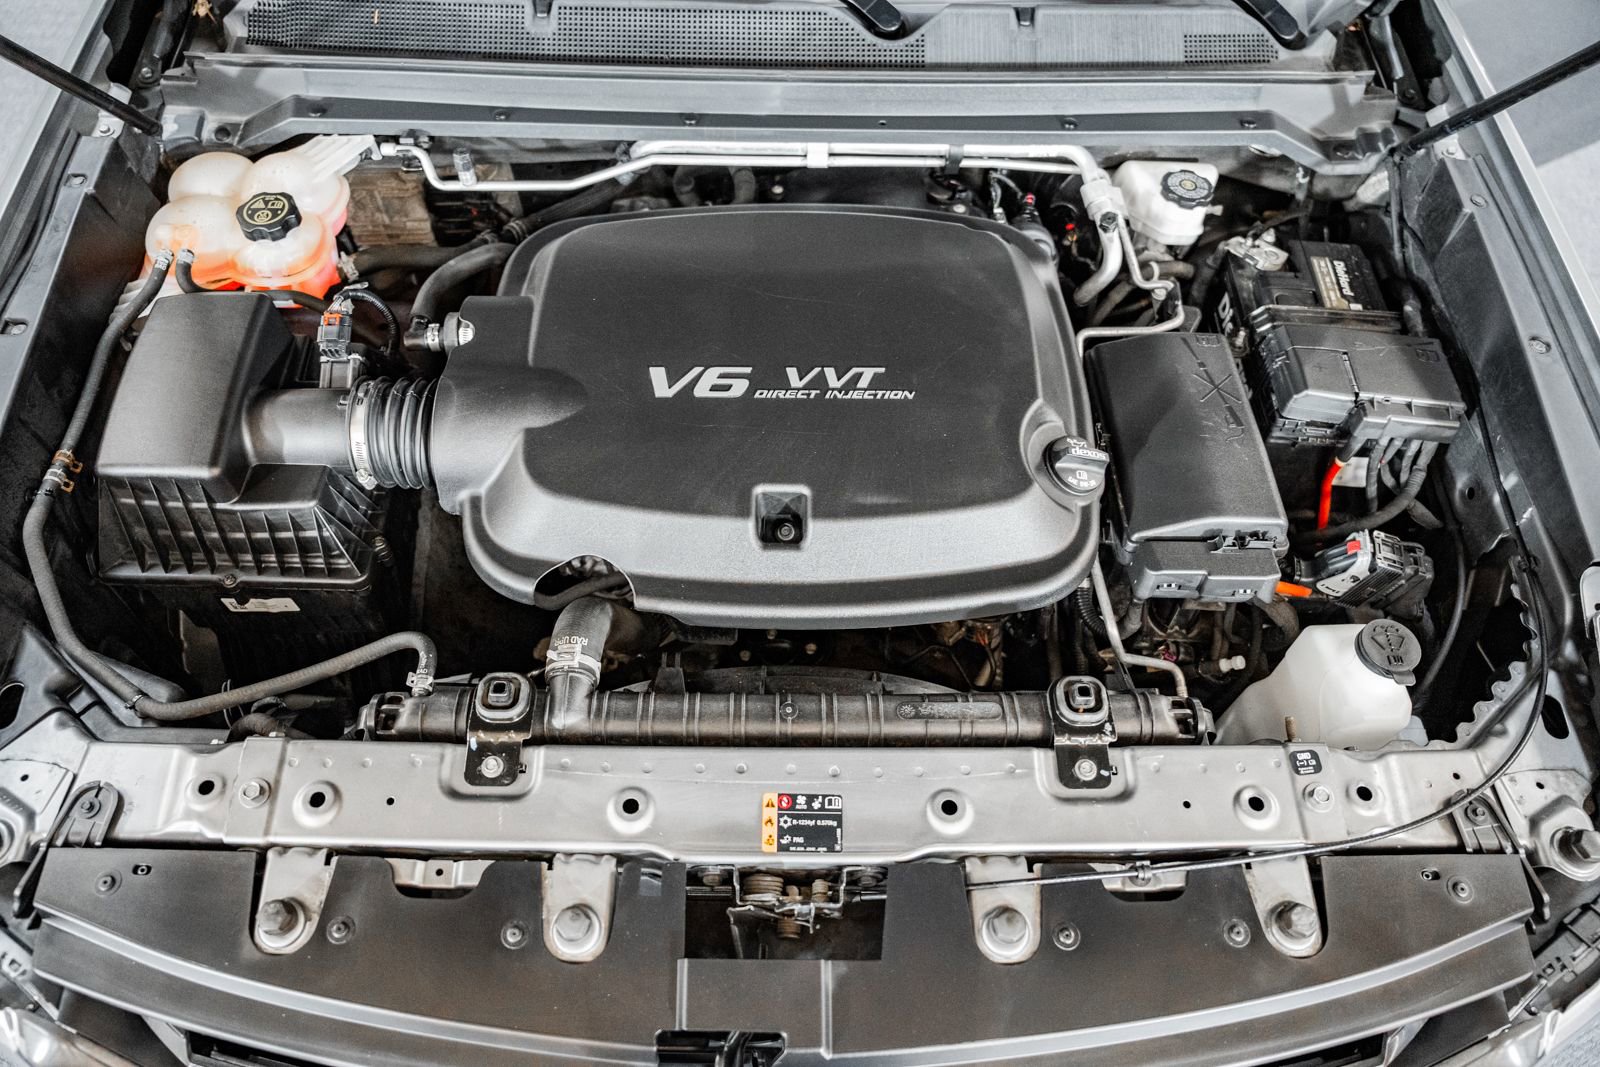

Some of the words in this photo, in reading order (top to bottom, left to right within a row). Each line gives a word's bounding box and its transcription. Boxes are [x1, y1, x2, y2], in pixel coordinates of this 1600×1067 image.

[649, 366, 753, 399] V6
[785, 366, 886, 389] VVT
[753, 389, 821, 399] DIRECT
[824, 390, 916, 400] INJECTION
[1071, 446, 1106, 460] dexos
[570, 635, 589, 646] RAD
